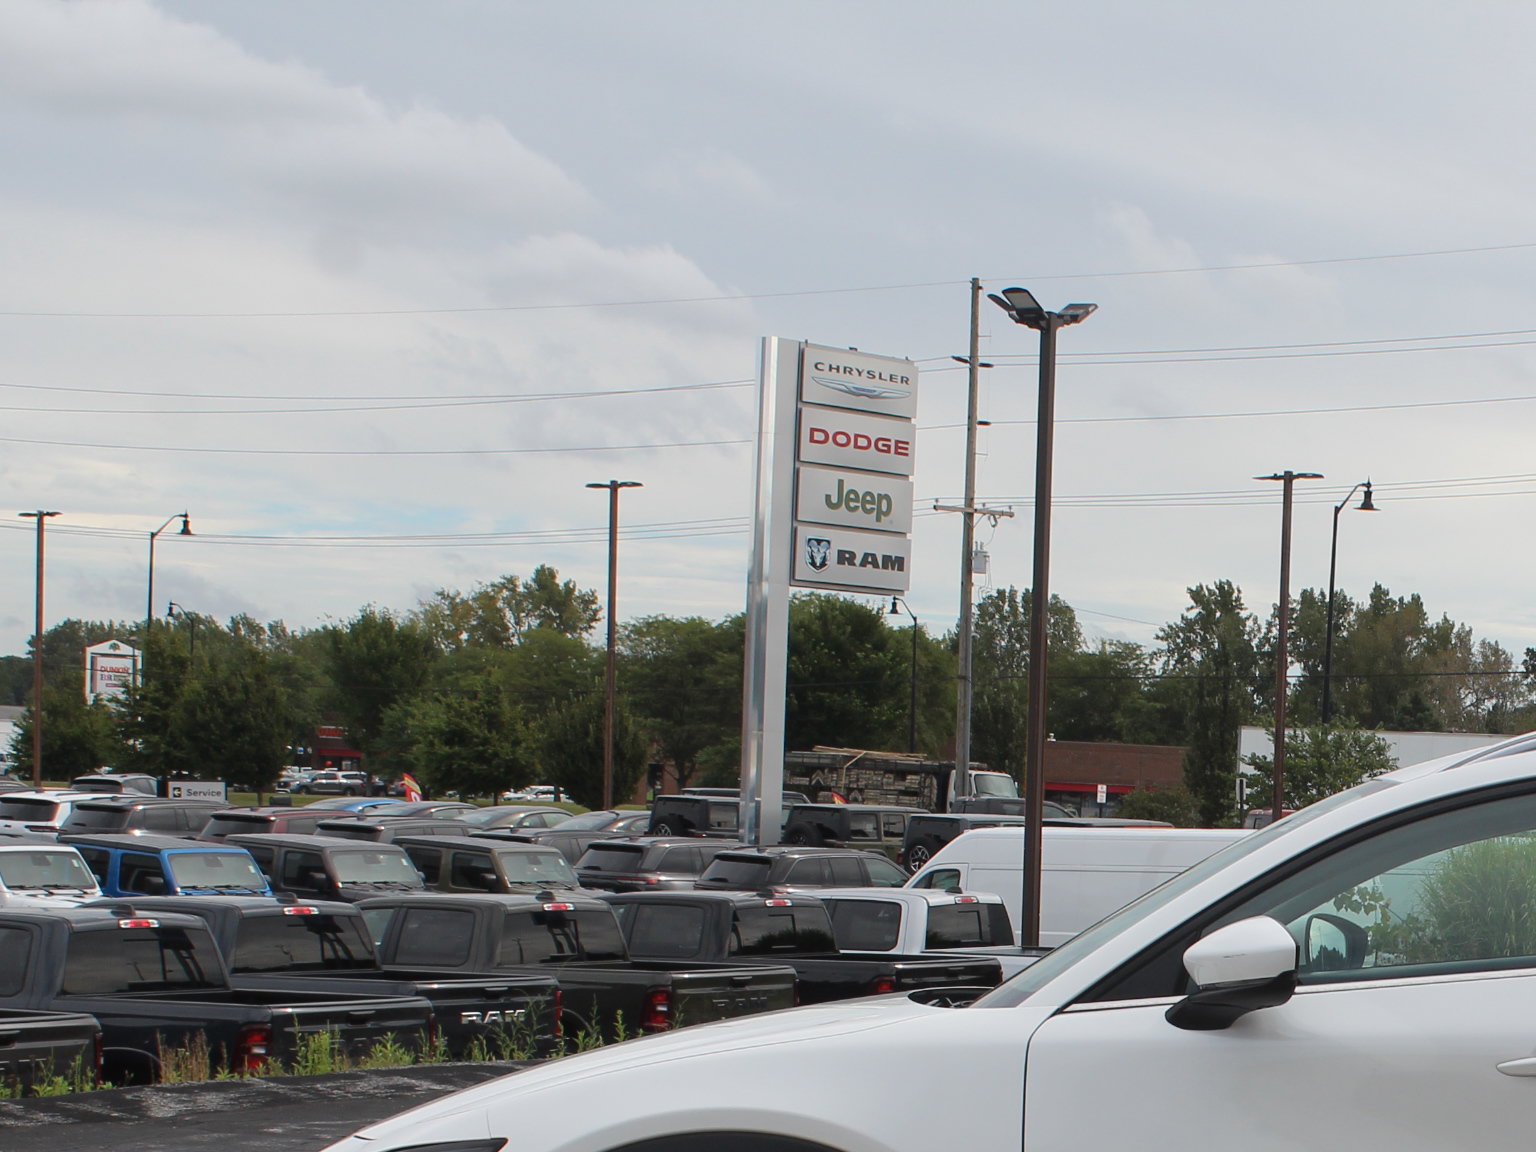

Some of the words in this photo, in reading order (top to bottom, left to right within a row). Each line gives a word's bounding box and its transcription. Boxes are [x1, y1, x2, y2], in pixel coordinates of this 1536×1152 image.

[814, 361, 910, 385] CHRYSLER
[809, 427, 910, 457] DODGE
[824, 478, 893, 523] Jeep
[836, 549, 905, 572] RAM
[186, 788, 222, 797] Service
